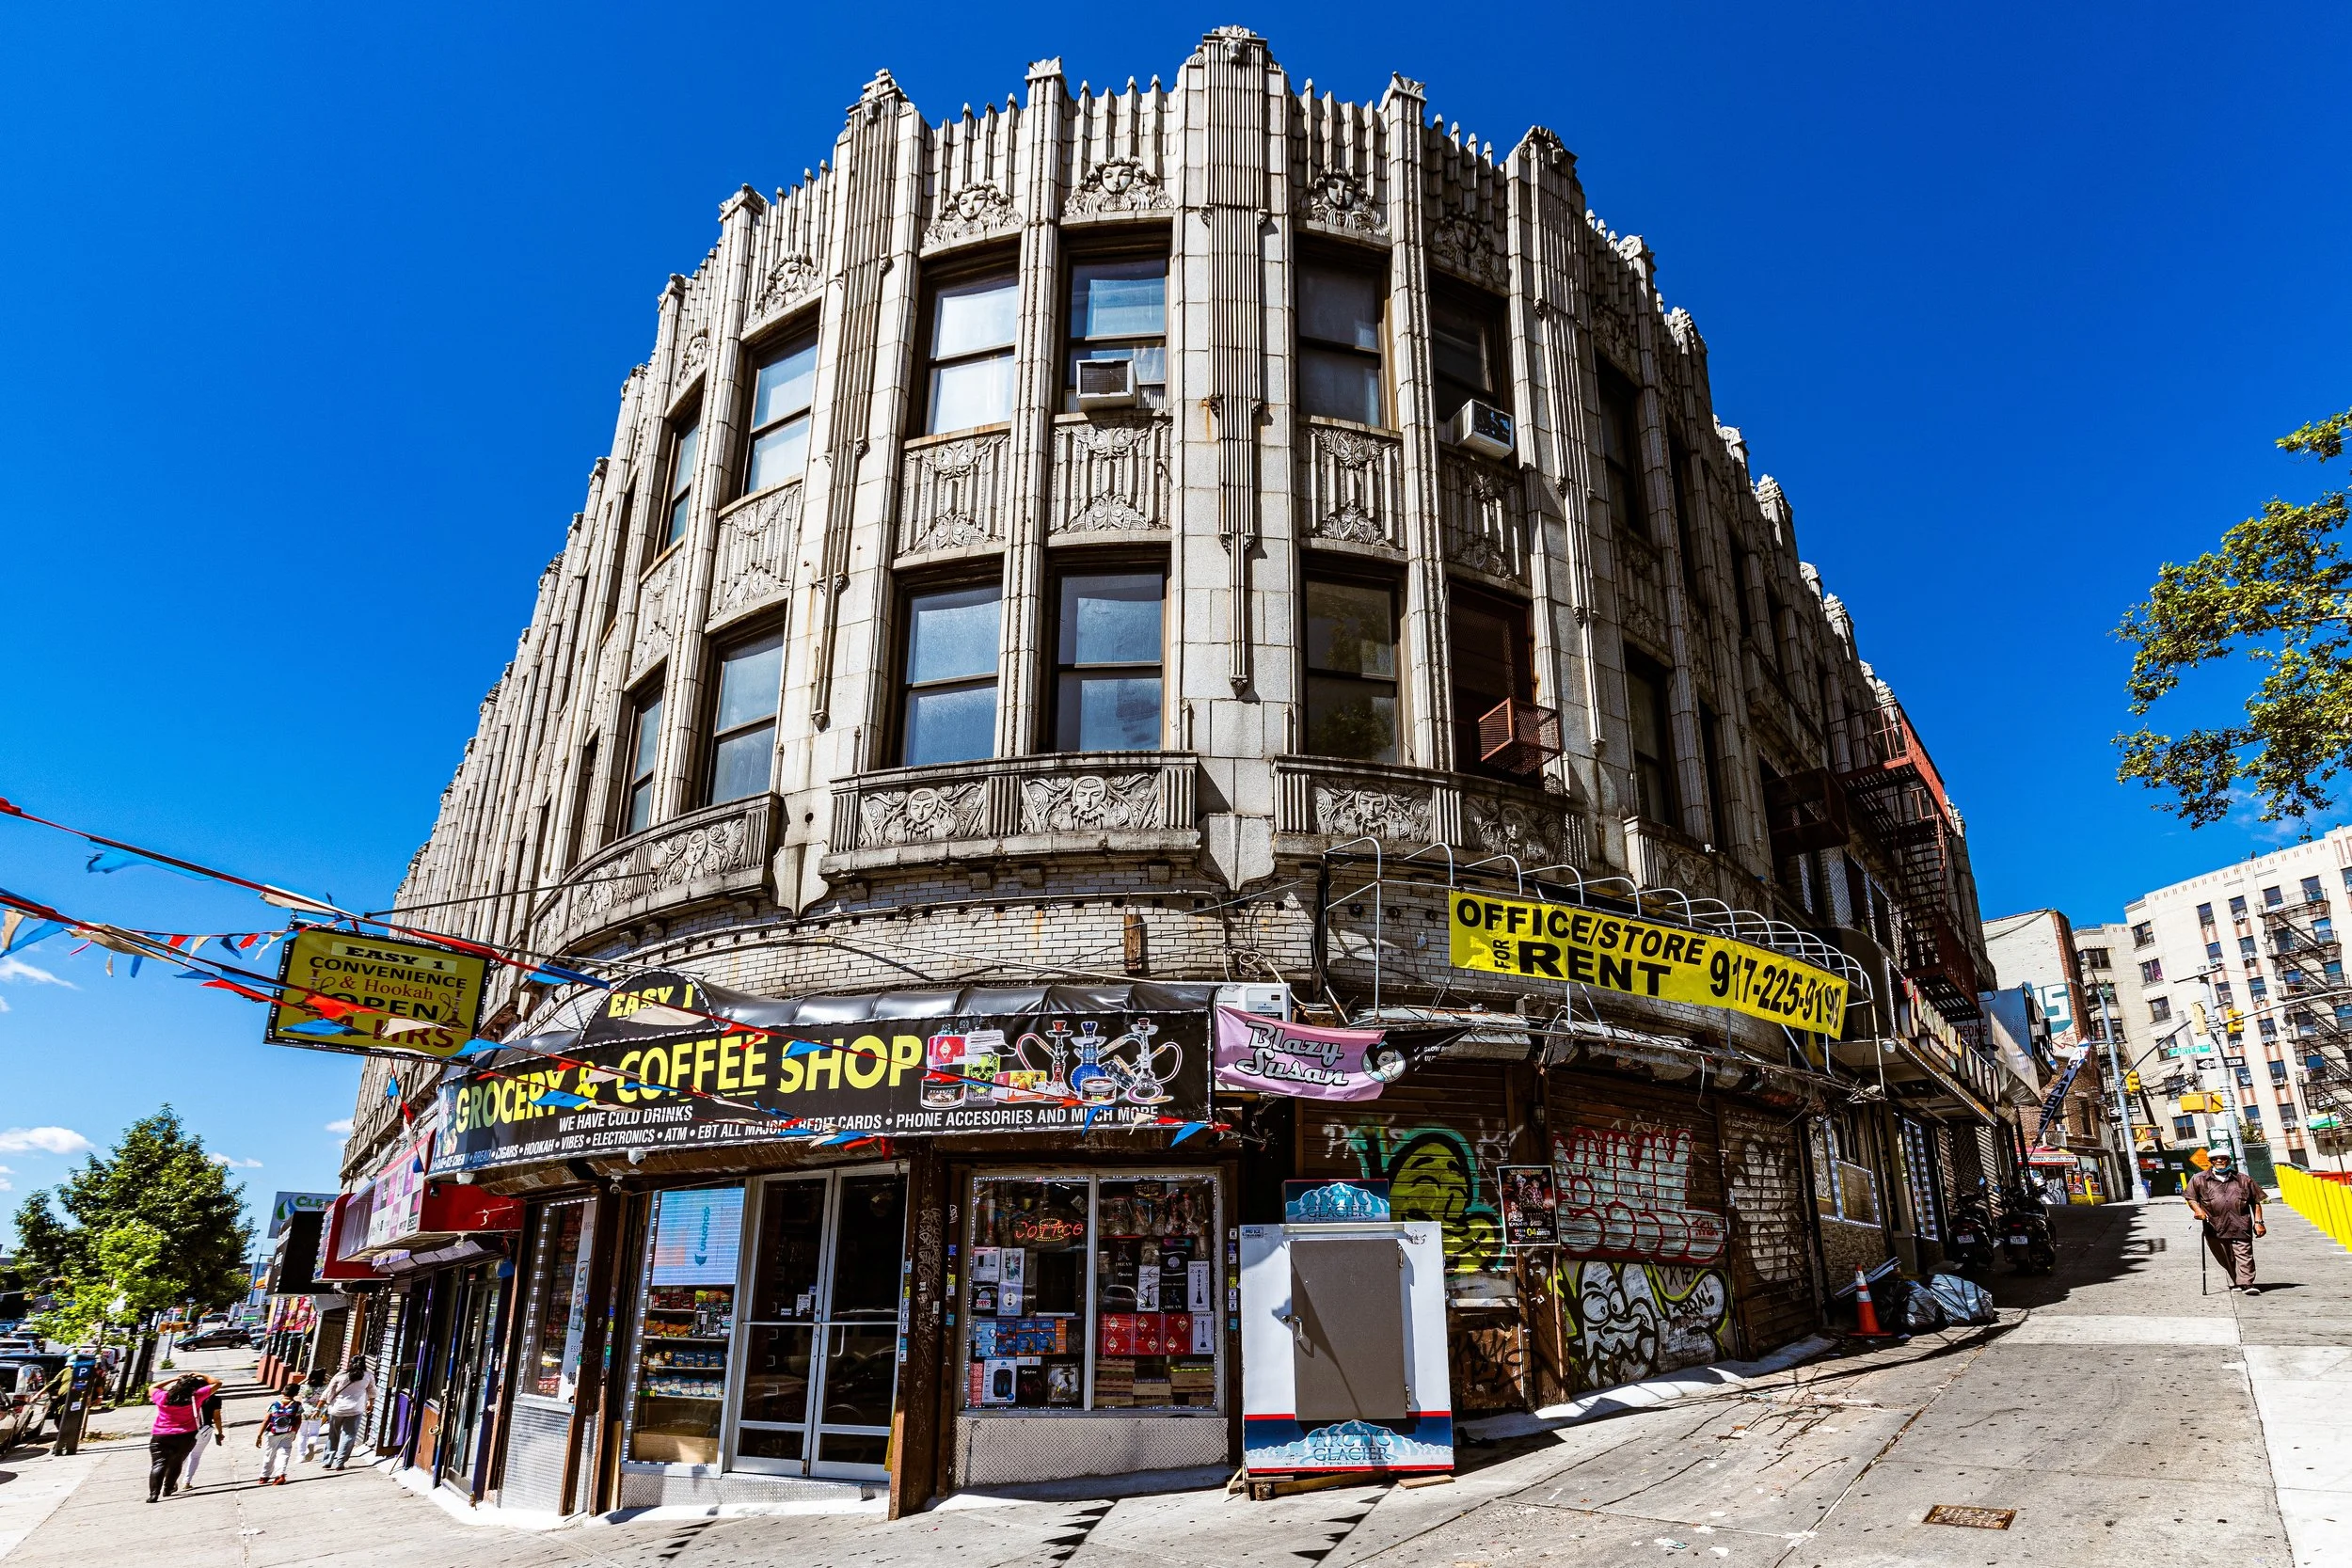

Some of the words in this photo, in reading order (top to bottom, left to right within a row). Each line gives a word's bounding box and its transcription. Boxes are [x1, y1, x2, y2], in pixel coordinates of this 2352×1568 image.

[1456, 898, 1707, 966] OFFICE/STORE
[345, 945, 419, 965] EASY
[433, 959, 445, 971] 1
[1493, 939, 1511, 970] FOR
[1518, 941, 1672, 997] RENT
[309, 956, 468, 990] CONVENIENCE
[339, 975, 356, 990] &
[363, 978, 434, 1001] Hookah
[608, 986, 674, 1019] EASY
[1246, 1020, 1344, 1068] Blazy
[2170, 1046, 2201, 1055] CARTER
[1234, 1048, 1349, 1086] Susan
[455, 1069, 566, 1133] GROCERY
[574, 1060, 599, 1112] &
[616, 1034, 769, 1103] COFFEE
[776, 1035, 923, 1094] SHOP
[559, 1116, 576, 1132] WE
[577, 1112, 607, 1130] HAVE
[608, 1111, 641, 1127] COLD
[643, 1105, 693, 1124] DRINKS
[495, 1144, 519, 1161] CIGARS
[523, 1139, 555, 1156] HOOKAH
[562, 1134, 585, 1150] VIBES
[592, 1129, 656, 1147] ELECTRONICS
[664, 1127, 688, 1142] ATM
[697, 1125, 718, 1139] EBT
[720, 1124, 742, 1138] ALL
[744, 1119, 787, 1135] MAJOR
[790, 1117, 835, 1132] REDIT
[837, 1115, 882, 1130] CARDS
[896, 1113, 942, 1128] PHONE
[946, 1109, 1033, 1127] ACCESORIES
[1037, 1109, 1067, 1124] AND
[1307, 1191, 1369, 1206] ARCTIC
[1307, 1206, 1370, 1218] GLACIER
[700, 1206, 710, 1252] dolphin
[79, 1368, 88, 1377] P
[1312, 1428, 1391, 1448] ARCTIC
[1313, 1447, 1391, 1461] GLACIER
